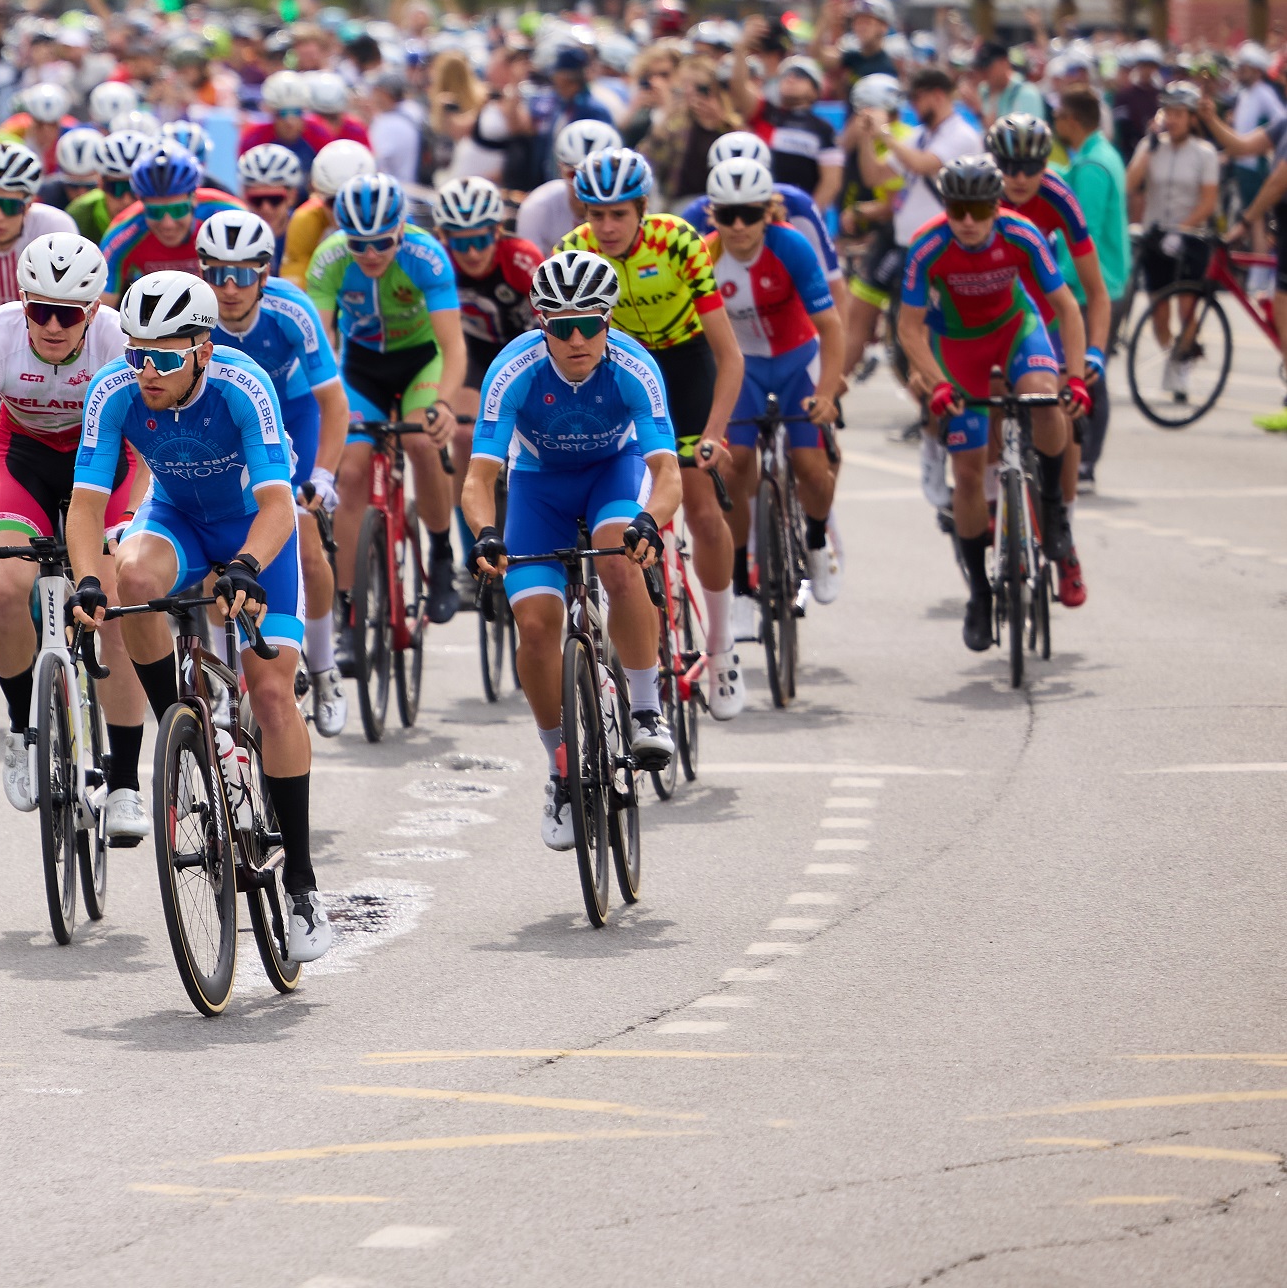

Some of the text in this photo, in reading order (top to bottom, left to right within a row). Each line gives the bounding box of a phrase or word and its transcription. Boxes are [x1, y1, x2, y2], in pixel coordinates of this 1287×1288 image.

[310, 243, 347, 280] КУБАН
[4, 395, 84, 410] BELARU
[86, 371, 136, 436] PC BAIX EBRE
[219, 367, 275, 434] PC BAIX EBRE
[487, 349, 539, 414] PC BAIX EBRE
[624, 357, 650, 379] BAIX
[646, 378, 663, 411] EBRE
[557, 432, 590, 441] BAIX
[593, 422, 623, 439] EBRE
[47, 588, 56, 637] LOOK
